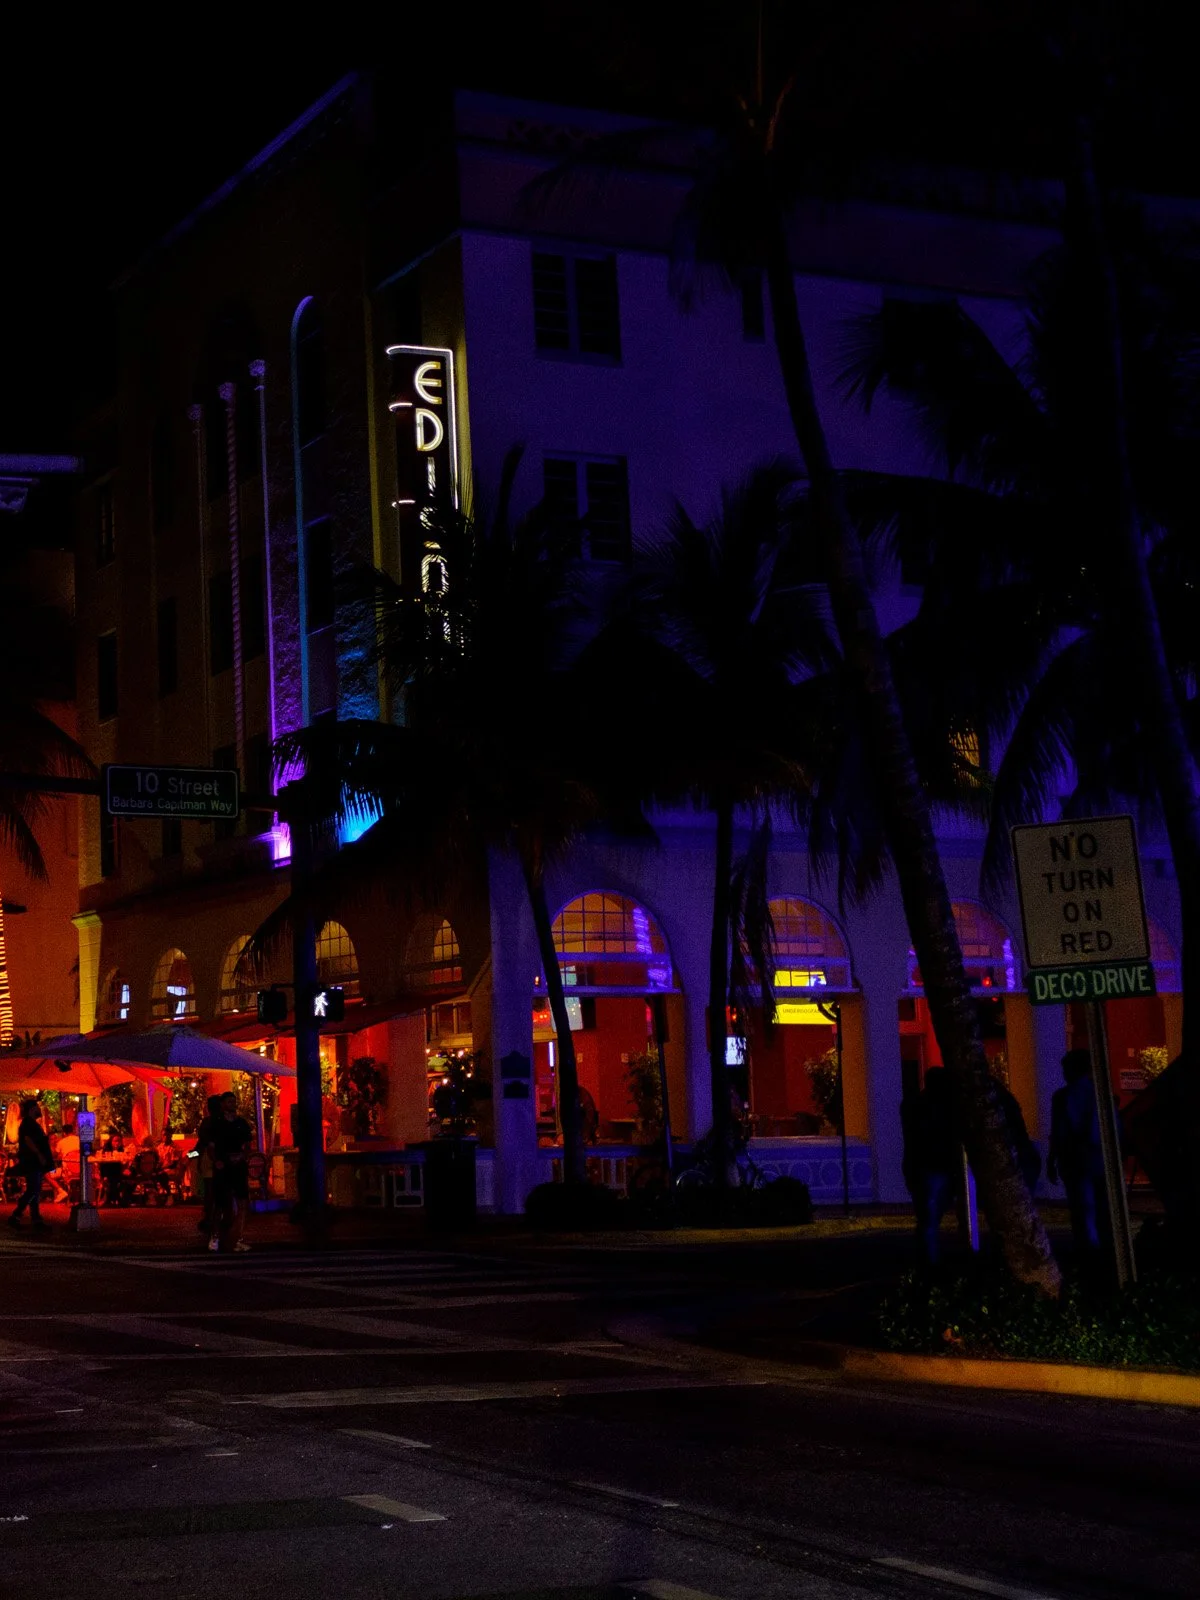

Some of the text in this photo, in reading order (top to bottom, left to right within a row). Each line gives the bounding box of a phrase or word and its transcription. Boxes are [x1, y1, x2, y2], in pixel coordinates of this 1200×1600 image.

[135, 771, 220, 797] 10 Street
[112, 795, 153, 809] Barbara
[210, 799, 233, 814] Way
[1050, 833, 1098, 862] NO
[1041, 867, 1114, 894] TURN
[1062, 899, 1103, 924] ON
[1060, 930, 1113, 955] RED
[1033, 964, 1152, 1001] DECO DRIVE
